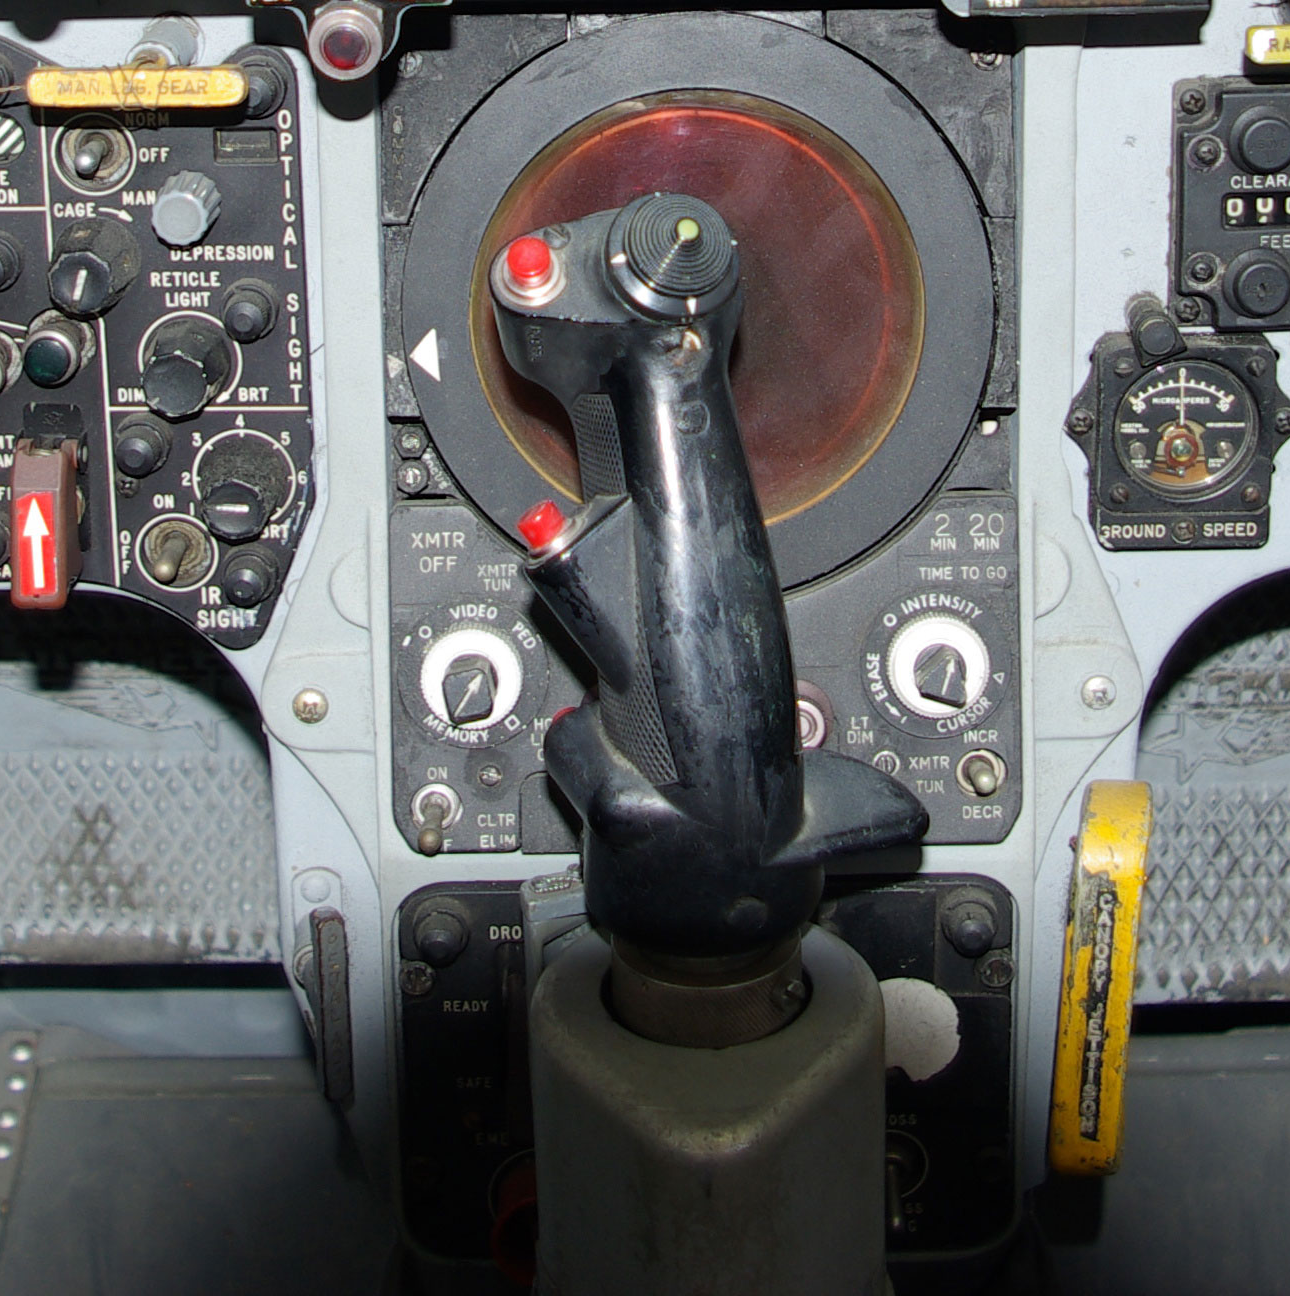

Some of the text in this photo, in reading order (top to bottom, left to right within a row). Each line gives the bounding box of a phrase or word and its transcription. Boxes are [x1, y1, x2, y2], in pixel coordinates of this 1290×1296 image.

[139, 148, 170, 163] OFF
[277, 109, 298, 270] OPTICAL
[53, 203, 96, 218] CAGE
[151, 272, 220, 288] RETICLE
[165, 291, 210, 307] LIGHT
[238, 388, 269, 402] BRT
[153, 495, 175, 509] ON
[1100, 522, 1258, 538] GROUND SPEED
[411, 531, 465, 548] XMTR
[930, 537, 1001, 551] MIN MIN
[419, 556, 458, 574] OFF
[919, 567, 1007, 580] TIME TO GO
[201, 587, 222, 605] IR
[449, 603, 498, 621] VIDEO
[900, 593, 983, 620] INTENSITY
[512, 621, 537, 650] PED
[867, 652, 889, 703] ERASE
[423, 714, 489, 744] MEMORY
[963, 730, 998, 743] INCR
[427, 767, 447, 780] ON
[962, 806, 1002, 819] DECR
[442, 998, 490, 1014] READY
